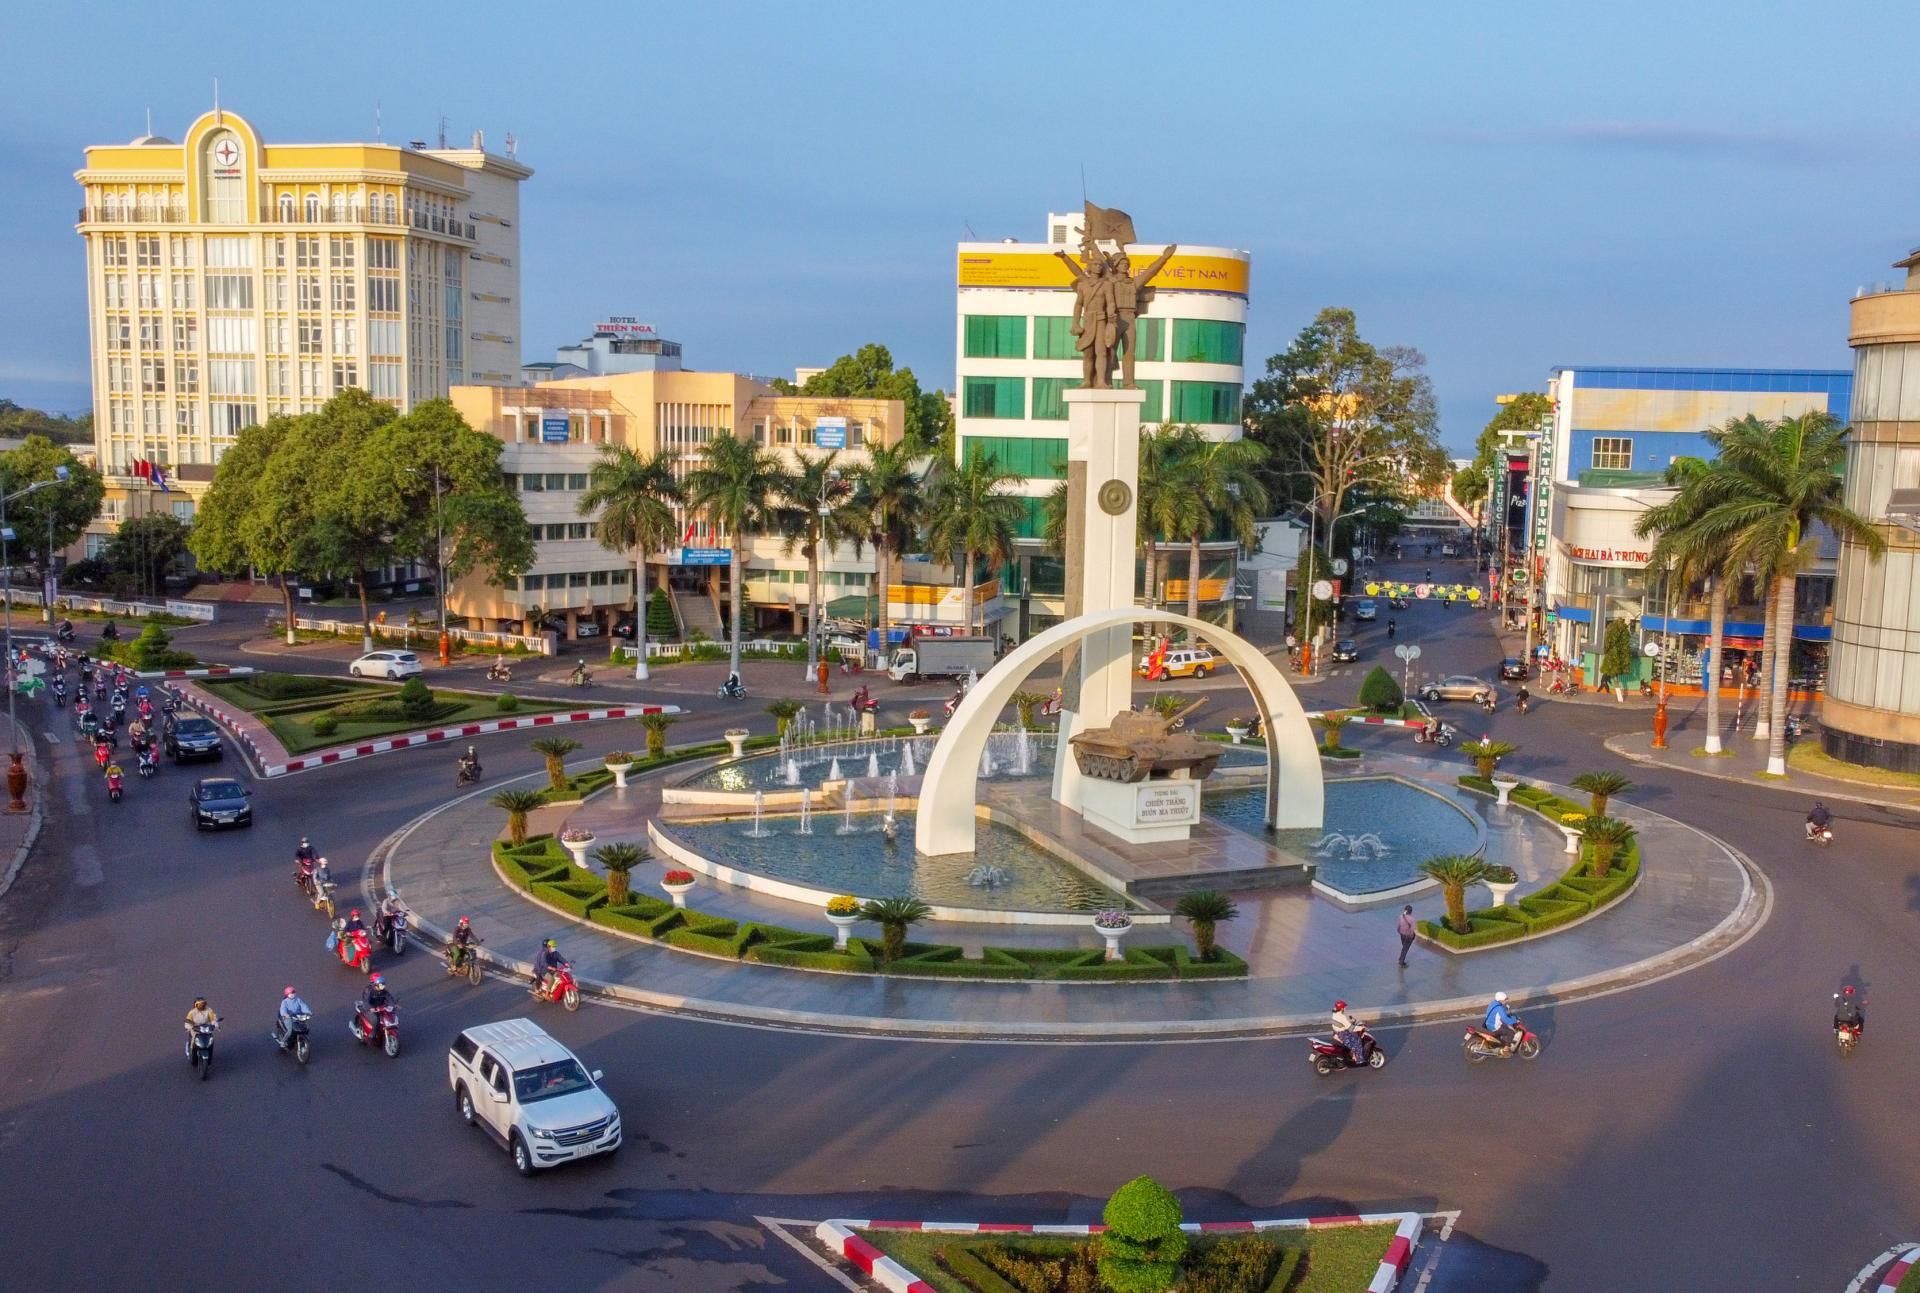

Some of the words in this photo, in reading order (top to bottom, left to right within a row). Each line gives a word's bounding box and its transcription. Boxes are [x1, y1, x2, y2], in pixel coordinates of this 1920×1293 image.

[1163, 266, 1197, 281] VIỆT
[1198, 268, 1228, 280] NAM
[609, 316, 638, 324] HOTEL
[596, 323, 628, 332] THIÊN
[631, 325, 653, 333] NGA
[1537, 539, 1545, 547] 2
[1585, 549, 1599, 560] HAI
[1601, 547, 1613, 561] BÀ
[1614, 550, 1649, 563] TRƯNG
[1159, 808, 1169, 816] MA
